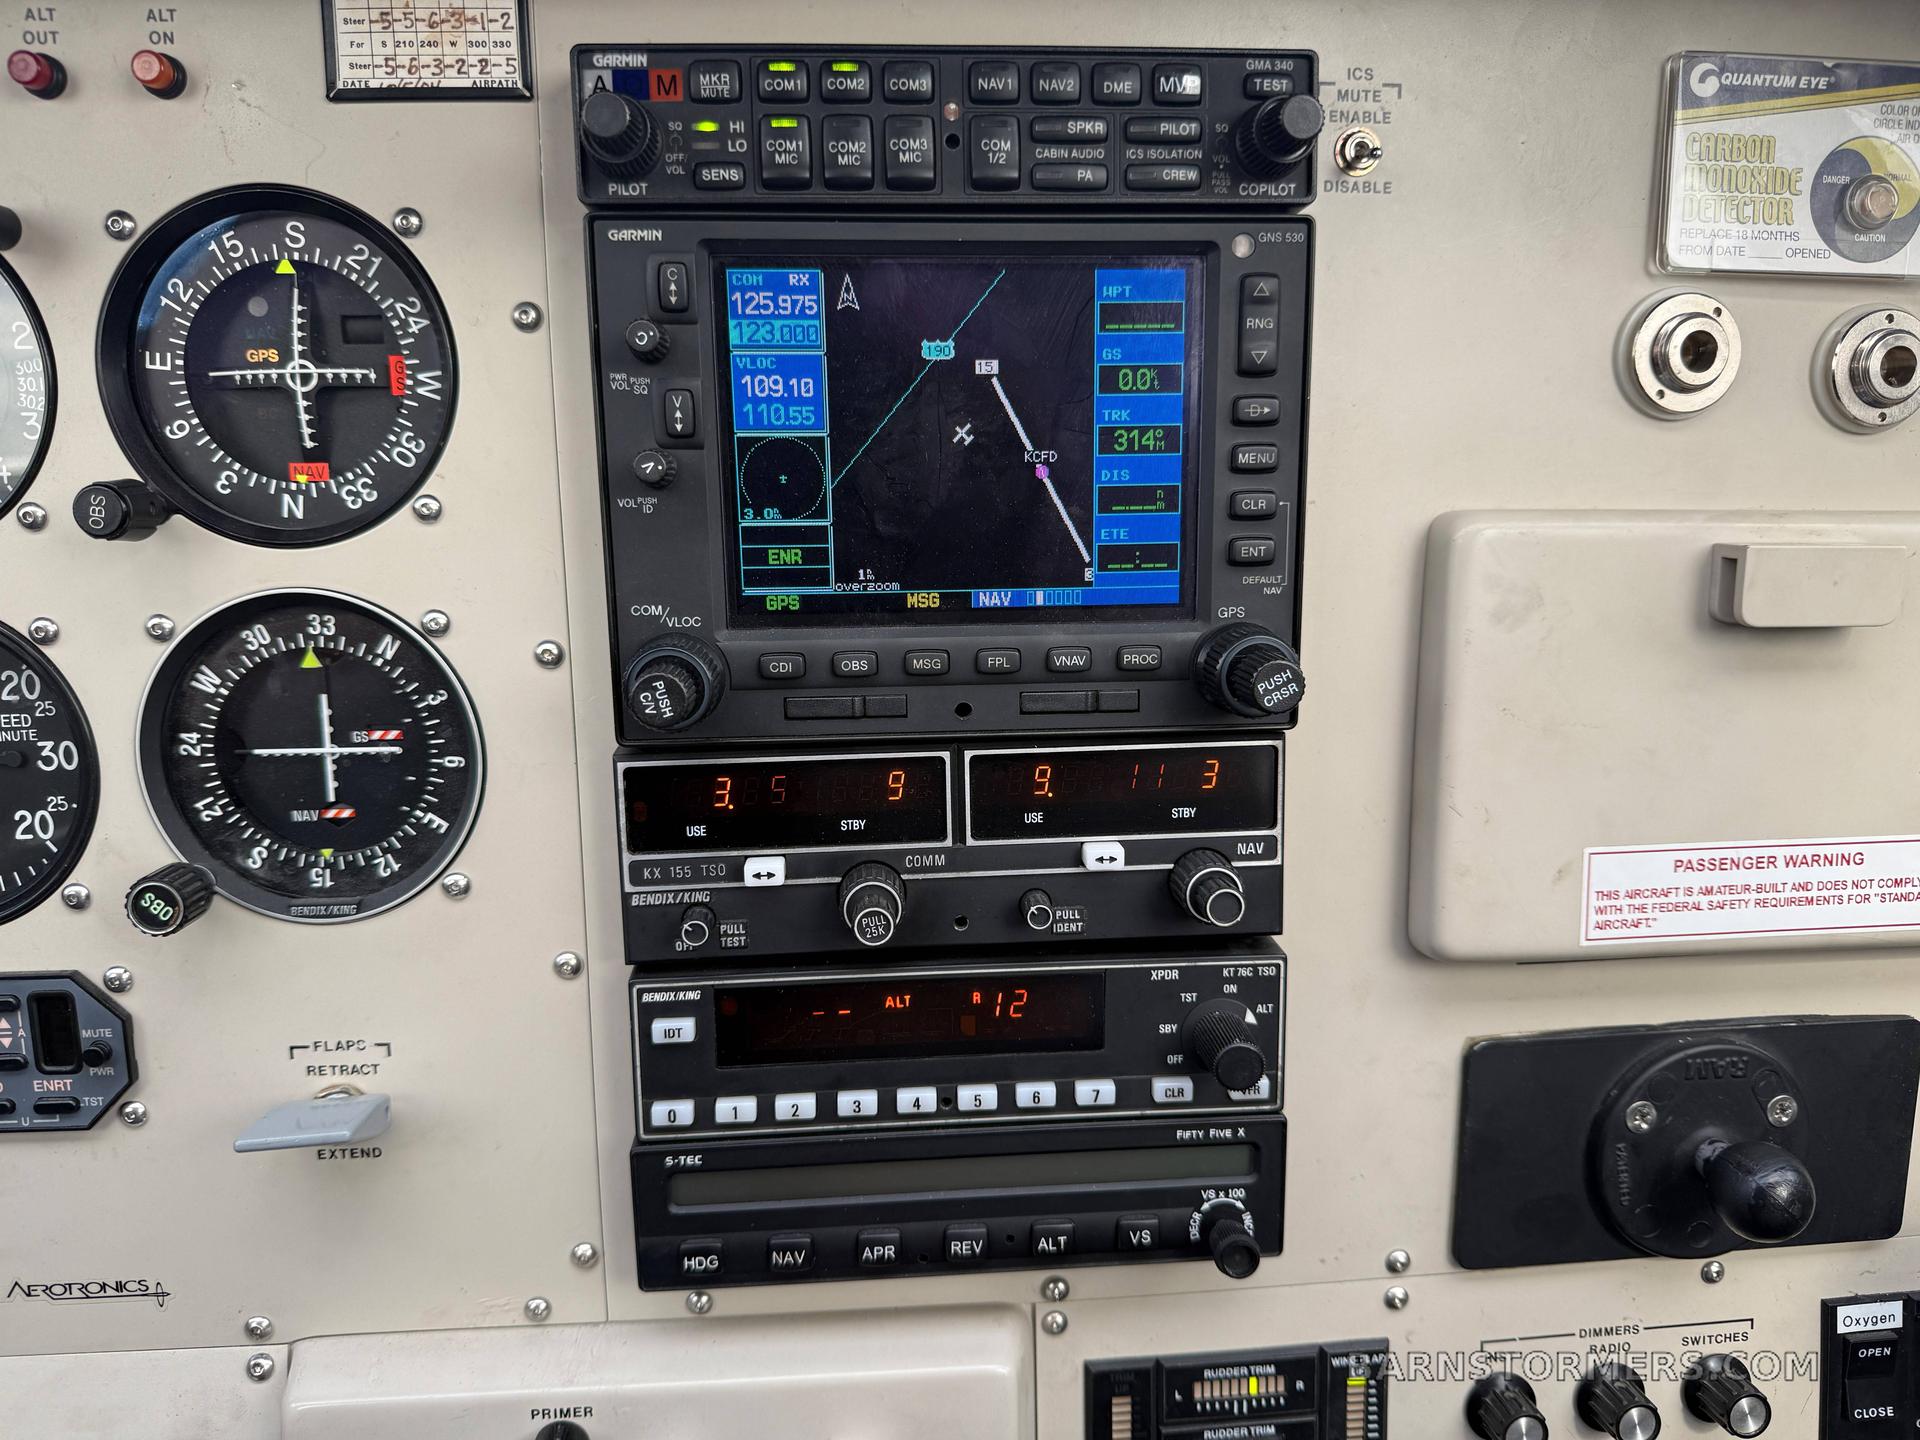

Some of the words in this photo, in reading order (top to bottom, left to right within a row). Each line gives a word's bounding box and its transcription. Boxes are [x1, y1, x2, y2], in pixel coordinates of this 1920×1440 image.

[25, 8, 56, 22] ALT
[147, 9, 177, 22] ALT
[343, 17, 366, 26] Steer
[23, 30, 59, 45] OUT
[149, 31, 175, 45] ON
[350, 41, 365, 49] For
[395, 40, 415, 48] 210
[420, 40, 439, 48] 240
[468, 40, 488, 48] 300
[492, 40, 512, 48] 330
[349, 62, 372, 70] Steer
[593, 54, 647, 67] GARMIN
[1246, 60, 1271, 70] GMA
[1274, 61, 1293, 71] 340
[700, 74, 730, 86] MKR
[1347, 68, 1374, 81] ICS
[1721, 72, 1796, 88] QUANTUM
[765, 79, 801, 91] COM1
[827, 78, 865, 90] COM2
[890, 79, 927, 91] COM3
[978, 78, 1012, 90] NAV1
[1039, 79, 1074, 92] NAV2
[1103, 82, 1132, 94] DME
[1254, 79, 1288, 91] TEST
[701, 87, 730, 98] MUTE
[1337, 89, 1382, 103] MUTE
[1329, 110, 1391, 124] ENABLE
[730, 121, 744, 133] HI
[1067, 123, 1103, 134] SPKR
[1160, 124, 1197, 135] PILOT
[728, 139, 747, 152] LO
[766, 140, 803, 152] COM1
[828, 141, 866, 153] COM2
[981, 140, 1011, 151] COM
[1686, 131, 1777, 163] CARBON
[775, 153, 798, 165] MIC
[838, 154, 861, 166] MIC
[988, 153, 1006, 164] 1/2
[1036, 149, 1068, 159] CABIN
[1072, 149, 1104, 159] AUDIO
[1126, 150, 1144, 159] ICS
[1147, 150, 1202, 159] ISOLATION
[702, 170, 739, 181] SENS
[1077, 170, 1093, 181] PA
[1163, 170, 1197, 181] CREW
[1684, 164, 1803, 196] MONOXIDE
[1823, 175, 1850, 184] DANGER
[608, 184, 648, 196] PILOT
[1239, 184, 1296, 196] COPILOT
[1324, 180, 1392, 194] DISABLE
[1682, 194, 1794, 225] DETECTOR
[608, 229, 662, 241] GARMIN
[1258, 233, 1282, 242] GNS
[1285, 233, 1304, 242] 530
[1680, 228, 1732, 240] REPLACE
[1736, 230, 1748, 240] 18
[1751, 230, 1800, 242] MONTHS
[1854, 233, 1886, 242] CAUTION
[1679, 245, 1713, 257] FROM
[1716, 246, 1746, 257] DATE
[1785, 248, 1831, 260] OPENED
[733, 274, 763, 286] COM
[789, 274, 809, 286] RX
[731, 292, 817, 316] 125.975
[1246, 318, 1273, 329] RNG
[731, 321, 818, 344] 123.000
[246, 349, 280, 363] GPS
[1102, 349, 1122, 360] GS
[736, 357, 777, 369] VLOC
[741, 375, 814, 398] 109.10
[742, 403, 815, 425] 110.55
[1102, 409, 1130, 421] TRK
[1024, 451, 1057, 462] KCFD
[1238, 453, 1275, 463] MENU
[1101, 469, 1130, 481] DIS
[1242, 500, 1266, 510] CLR
[1101, 528, 1129, 539] ETE
[768, 549, 802, 564] ENR
[1241, 547, 1266, 557] ENT
[1242, 576, 1282, 584] DEFAULT
[835, 582, 900, 592] overzoom
[1263, 587, 1282, 595] NAV
[766, 595, 800, 610] GPS
[907, 593, 940, 608] MSG
[979, 591, 1012, 607] NAV
[1218, 607, 1245, 618] GPS
[841, 660, 868, 671] OBS
[913, 659, 941, 669] MSG
[988, 658, 1010, 668] FPL
[1054, 655, 1086, 666] VNAV
[1124, 654, 1158, 665] PROC
[769, 662, 792, 673] CDI
[1257, 669, 1292, 695] PUSH
[1263, 683, 1298, 707] CRSR
[36, 740, 79, 771] 30
[290, 809, 320, 822] NAV
[14, 810, 55, 840] 20
[840, 819, 866, 831] STBY
[686, 826, 707, 837] USE
[1237, 842, 1264, 855] NAV
[905, 855, 945, 868] COMM
[1673, 855, 1777, 873] PASSENGER
[1783, 851, 1865, 869] WARNING
[643, 867, 661, 879] KX
[669, 866, 692, 878] 155
[700, 864, 726, 877] TSO
[1595, 889, 1620, 902] THIS
[1622, 887, 1681, 900] AIRCRAFT
[1683, 886, 1693, 898] IS
[1696, 882, 1788, 897] AMATEUR-BUILT
[1790, 881, 1814, 893] AND
[1817, 879, 1848, 892] DOES
[1851, 878, 1875, 890] NOT
[632, 891, 711, 906] BENDIX/KING
[1594, 903, 1623, 916] WITH
[1627, 902, 1649, 915] THE
[1652, 900, 1704, 913] FEDERAL
[1707, 898, 1752, 911] SAFETY
[1754, 894, 1844, 909] REQUIREMENTS
[1847, 893, 1871, 905] FOR
[1055, 909, 1081, 920] PULL
[720, 924, 746, 935] PULL
[1053, 922, 1083, 933] IDENT
[1593, 917, 1657, 931] AIRCRAFT."
[720, 936, 746, 947] TEST
[1151, 970, 1179, 981] XPDR
[642, 990, 701, 1003] BENDIX/KING
[885, 995, 911, 1008] ALT
[1180, 993, 1197, 1002] TST
[82, 1028, 113, 1038] MUTE
[664, 1027, 682, 1039] IDT
[1159, 1024, 1177, 1034] SBY
[314, 1039, 367, 1051] FLAPS
[90, 1067, 114, 1076] PWR
[307, 1063, 380, 1076] RETRACT
[33, 1079, 73, 1092] ENRT
[317, 1147, 382, 1160] EXTEND
[664, 1154, 703, 1167] S-TEC
[862, 1245, 895, 1262] APR
[951, 1239, 983, 1256] REV
[683, 1254, 719, 1271] HDG
[8, 1279, 150, 1300] AEROTRONICS
[1843, 1312, 1896, 1328] Oxygen
[1578, 1325, 1640, 1339] DIMMERS
[1681, 1331, 1749, 1347] SWITCHES
[1858, 1347, 1891, 1358] OPEN
[531, 1406, 594, 1420] PRIMER
[1854, 1406, 1894, 1419] CLOSE
